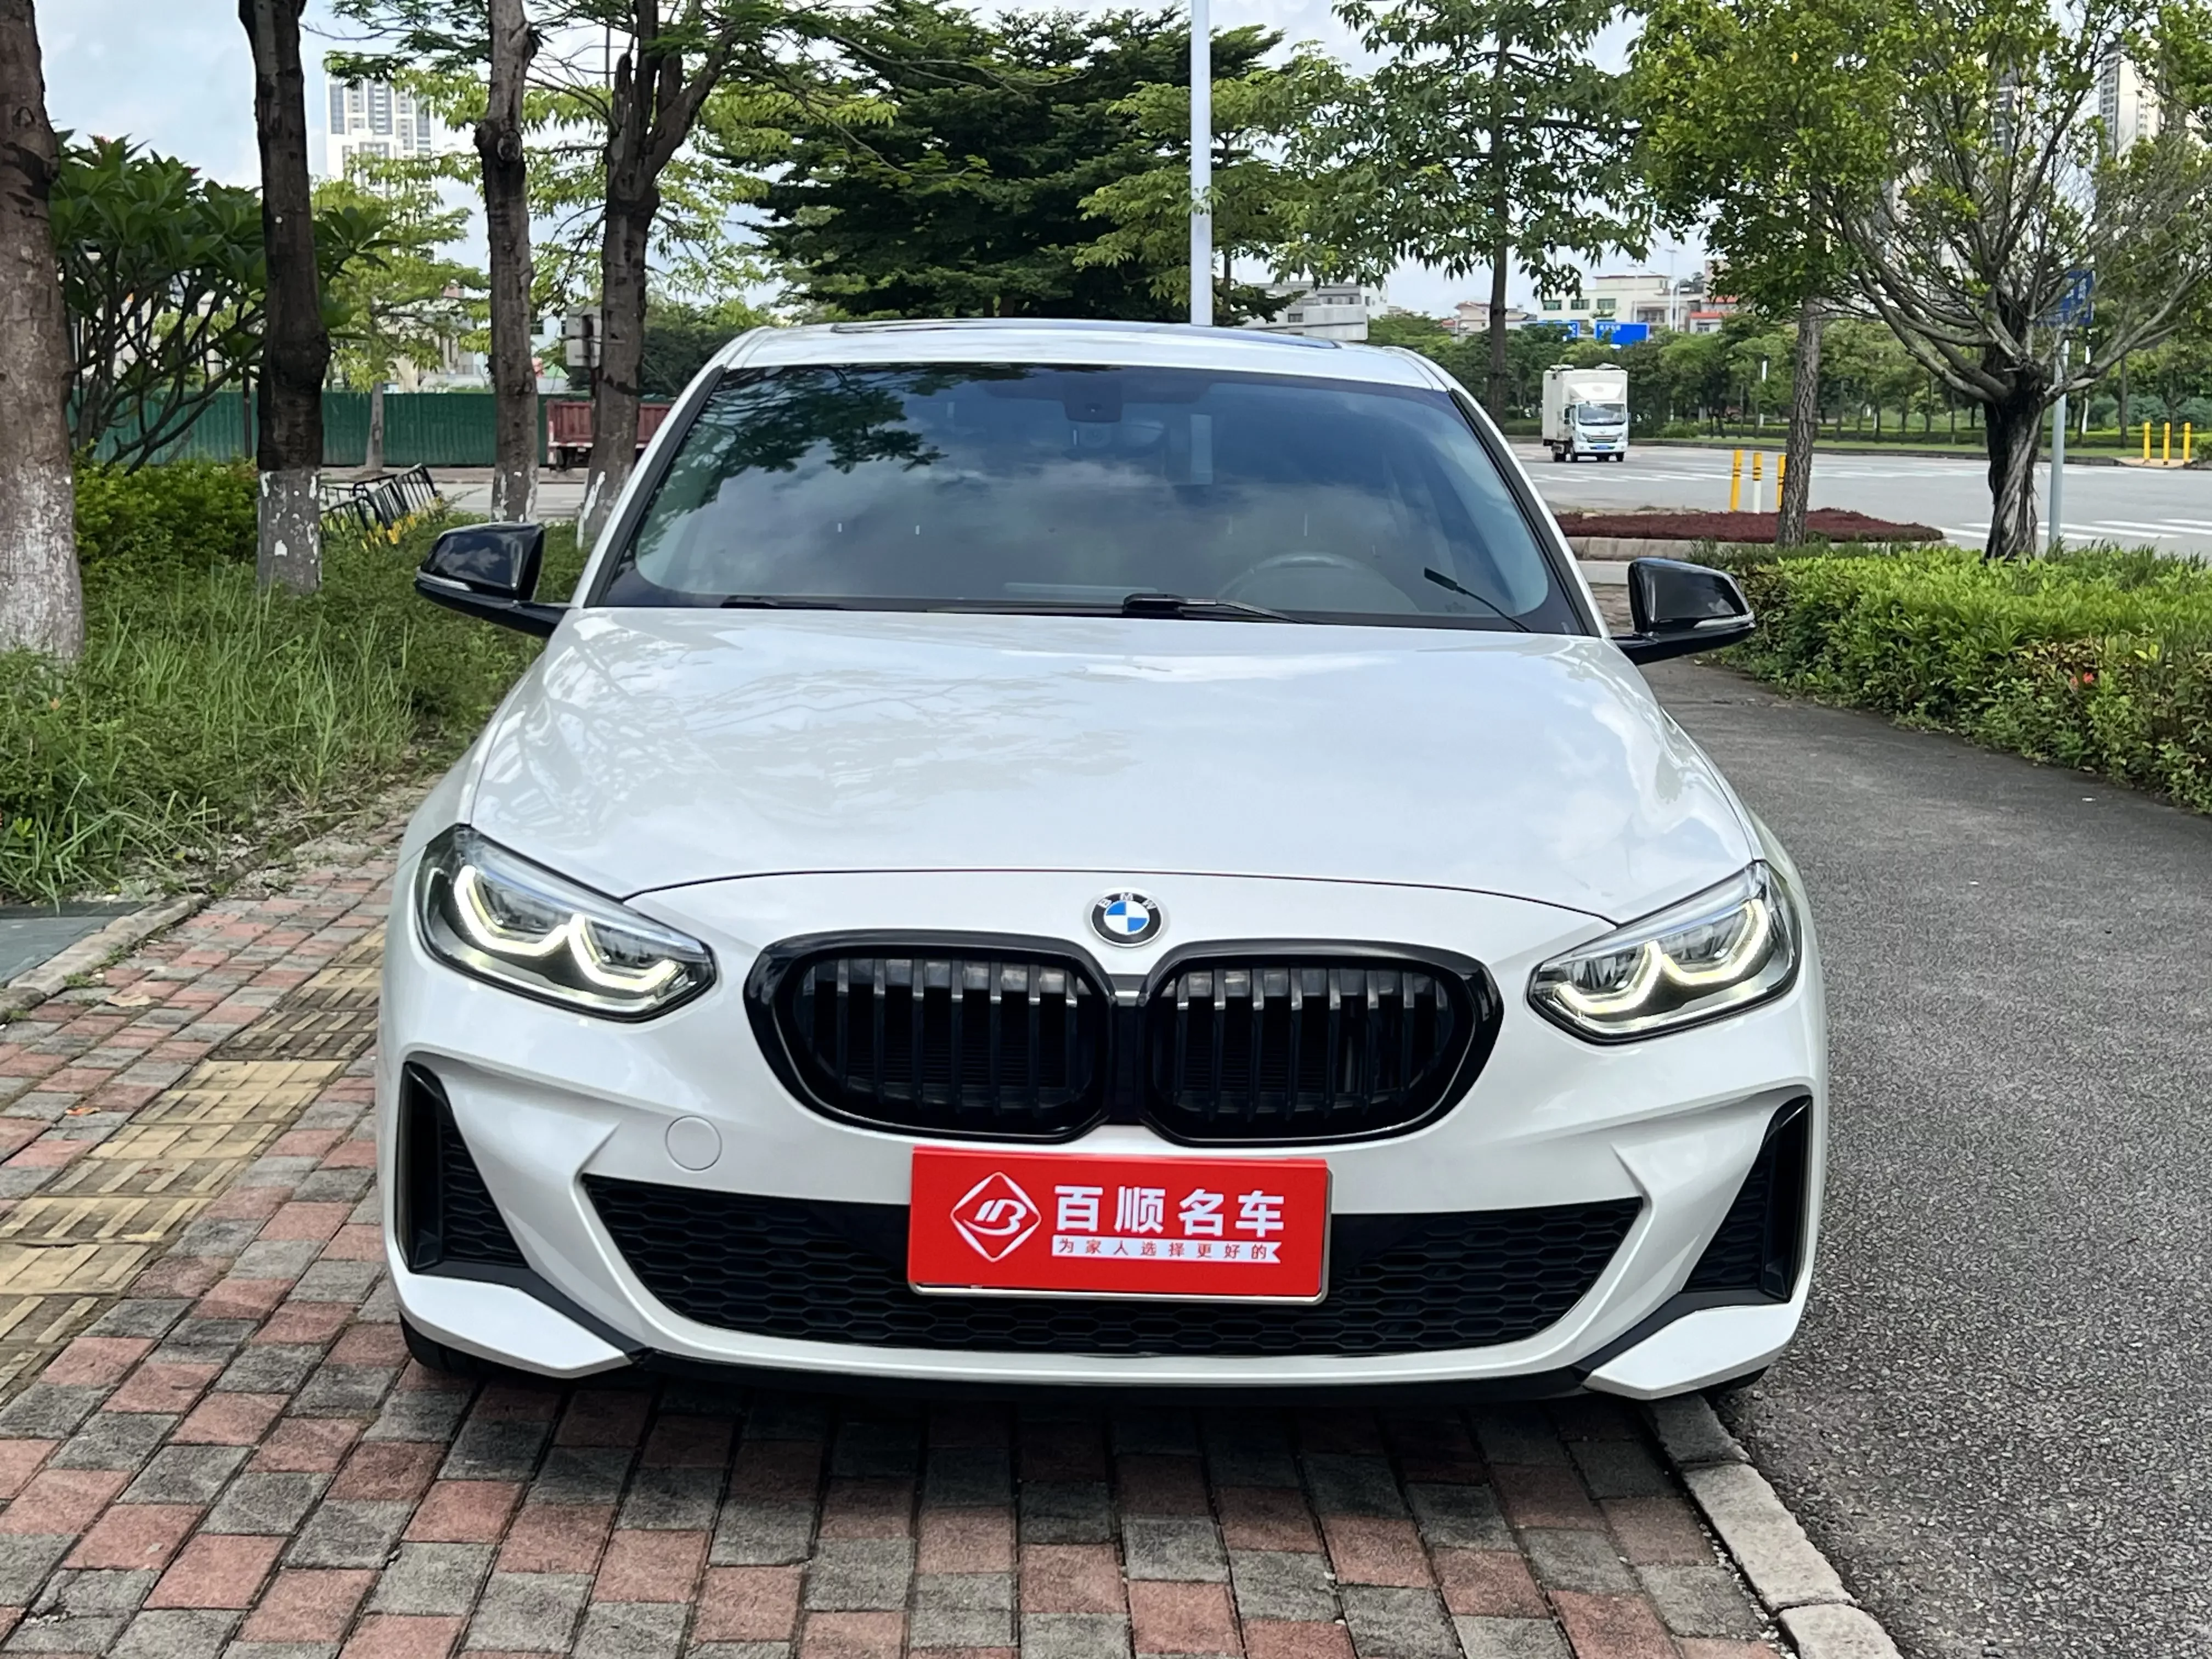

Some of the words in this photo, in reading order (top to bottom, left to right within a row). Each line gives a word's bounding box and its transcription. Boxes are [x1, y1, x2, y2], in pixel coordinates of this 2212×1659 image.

[1097, 892, 1157, 910] BMW
[1054, 1185, 1285, 1238] 百顺名车
[1058, 1238, 1268, 1260] 为家人选择更好的
